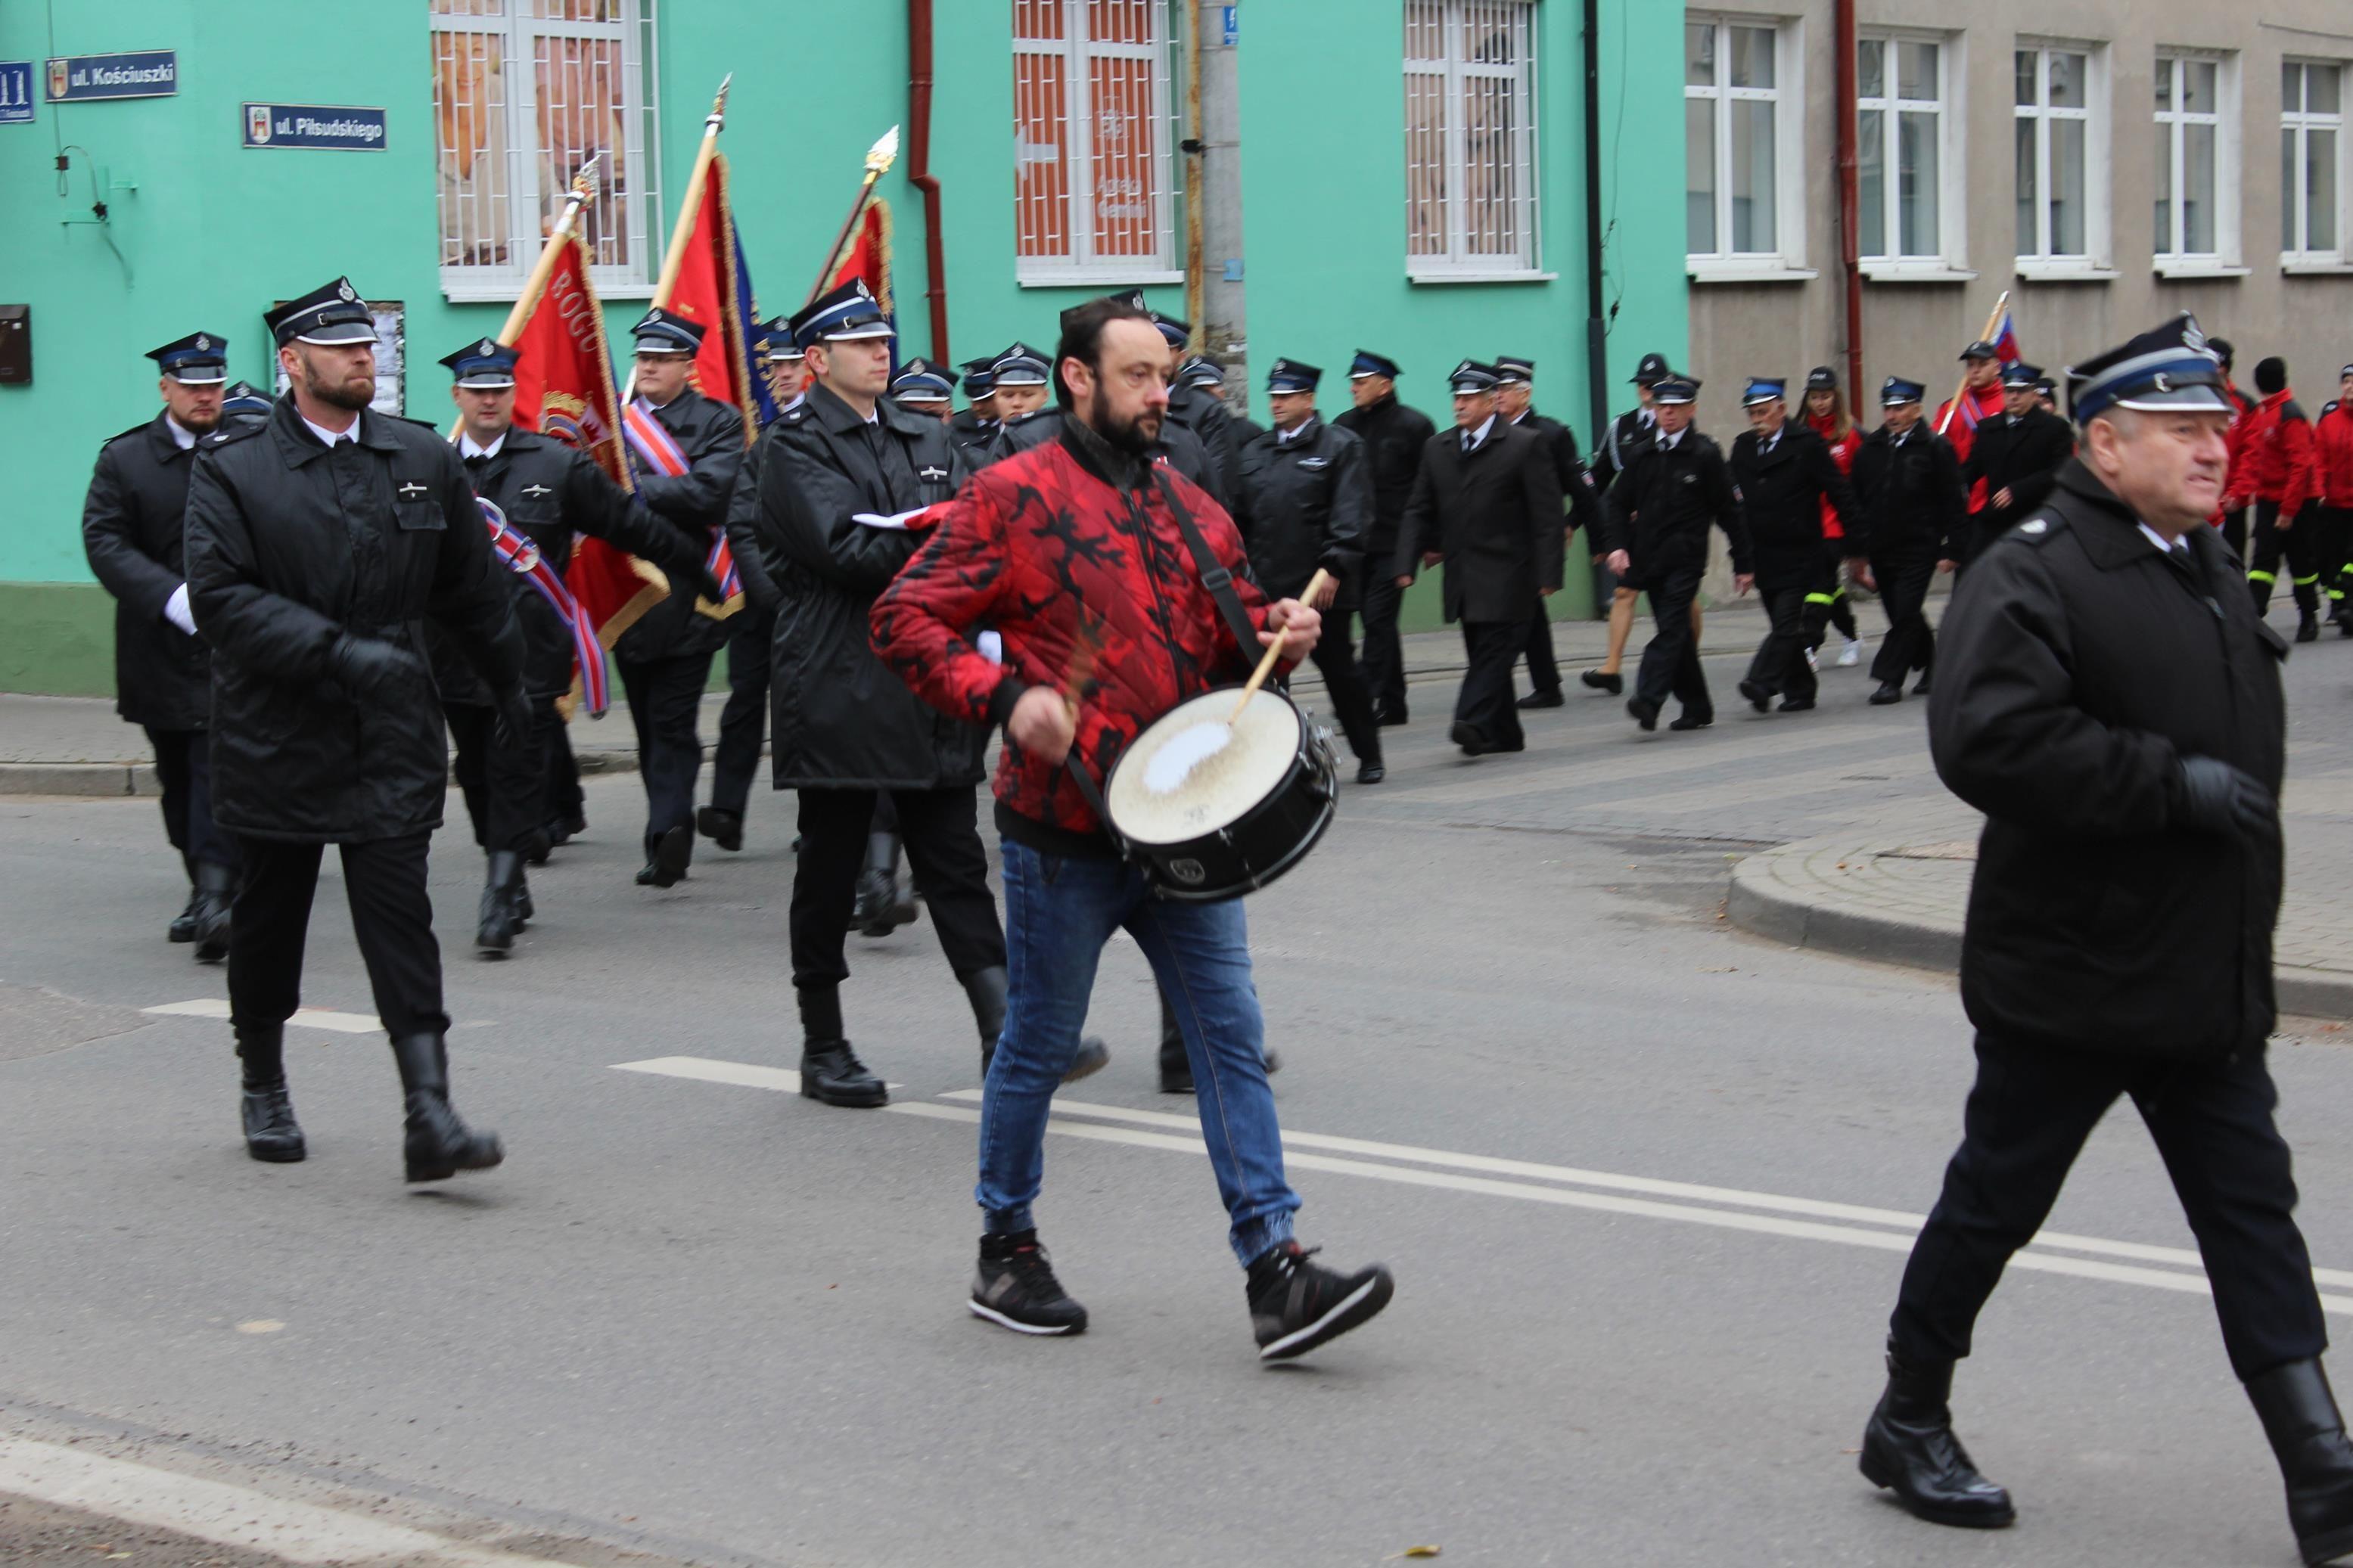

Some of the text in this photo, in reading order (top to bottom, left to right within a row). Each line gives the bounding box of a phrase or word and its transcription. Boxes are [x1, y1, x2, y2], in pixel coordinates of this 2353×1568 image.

[72, 64, 173, 86] ul. Kościuszki
[275, 118, 382, 141] ul. Piłsudskiego
